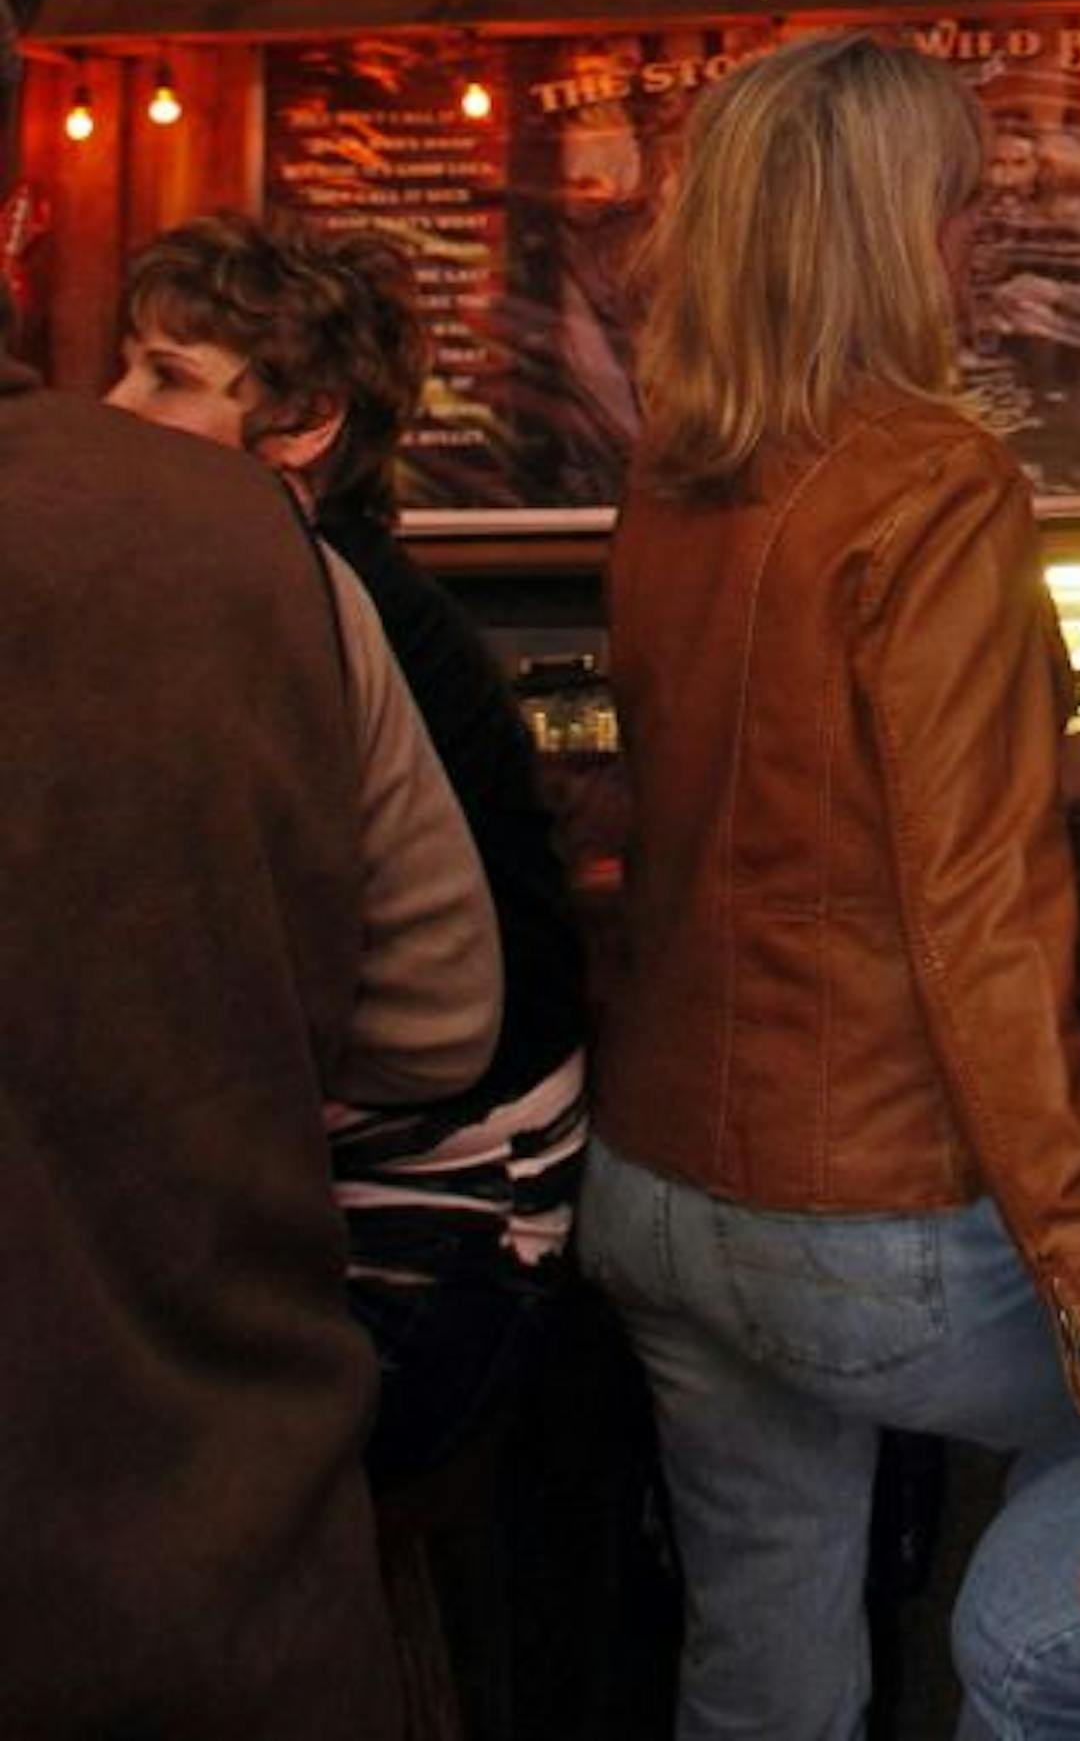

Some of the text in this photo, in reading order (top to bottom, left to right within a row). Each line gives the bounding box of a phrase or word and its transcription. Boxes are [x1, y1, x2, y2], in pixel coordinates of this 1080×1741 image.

[530, 66, 631, 113] THE
[642, 47, 750, 94] STO
[914, 19, 1041, 59] WILD
